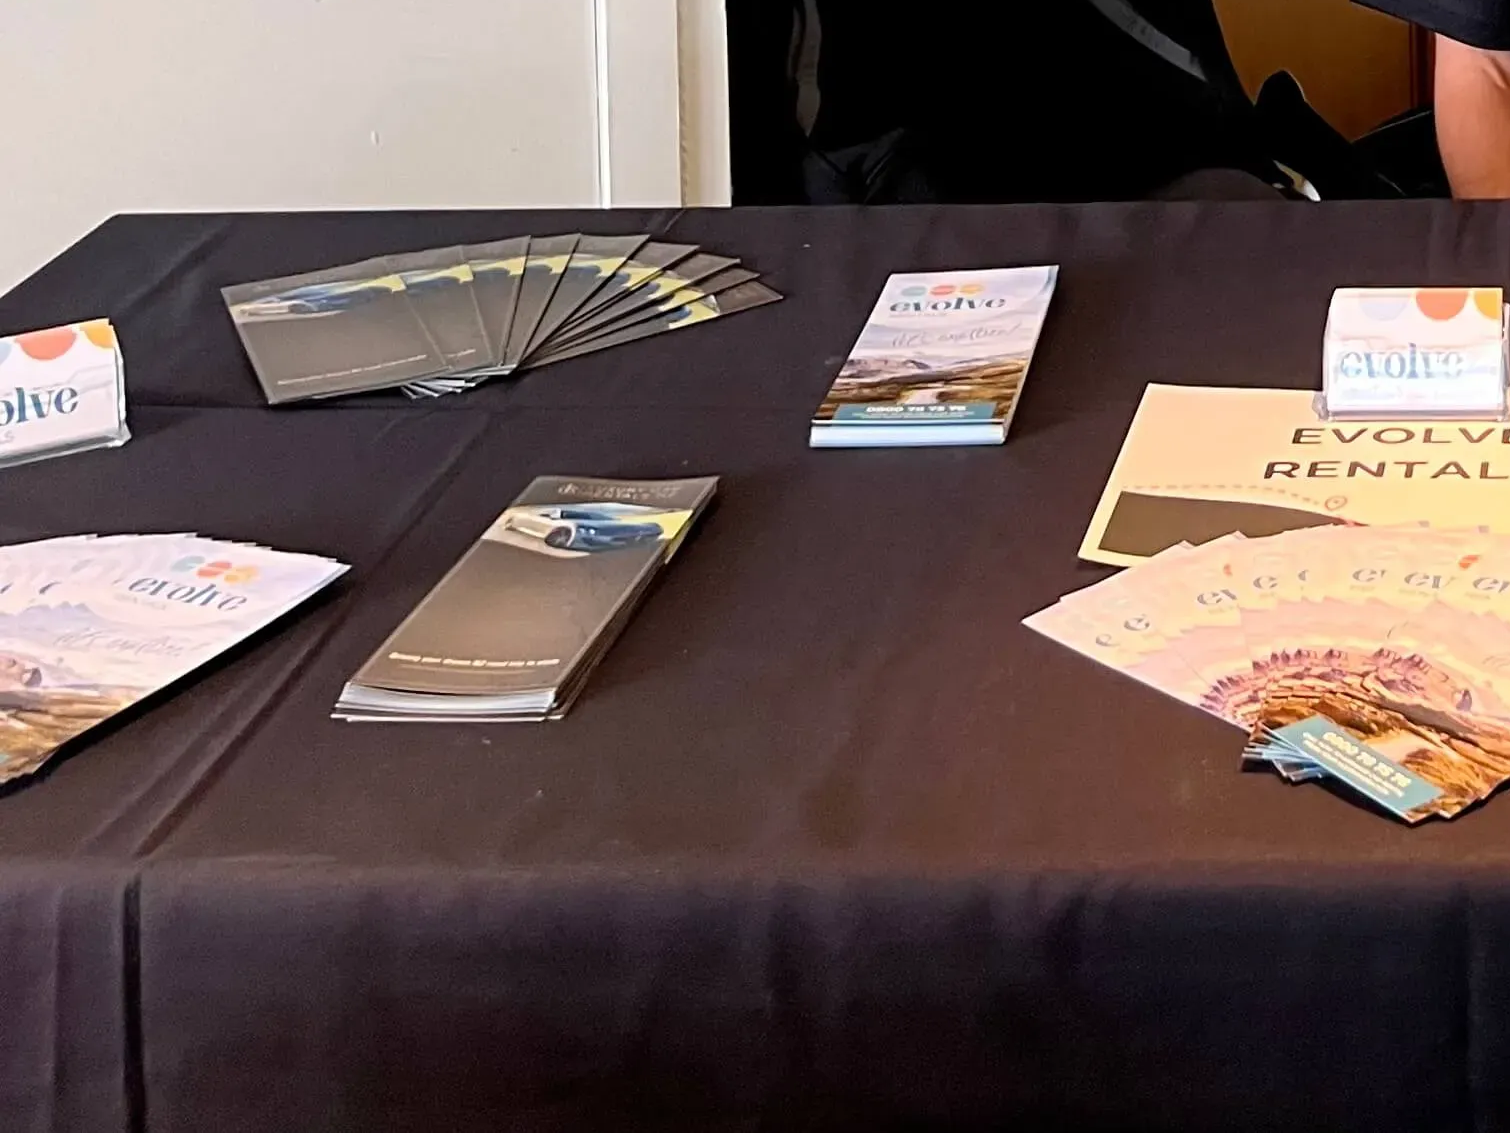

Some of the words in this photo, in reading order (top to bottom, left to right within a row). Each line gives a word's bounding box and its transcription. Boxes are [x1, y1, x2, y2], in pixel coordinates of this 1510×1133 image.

[889, 297, 1007, 313] evolve
[1340, 341, 1465, 380] evolve
[127, 576, 249, 612] evolve
